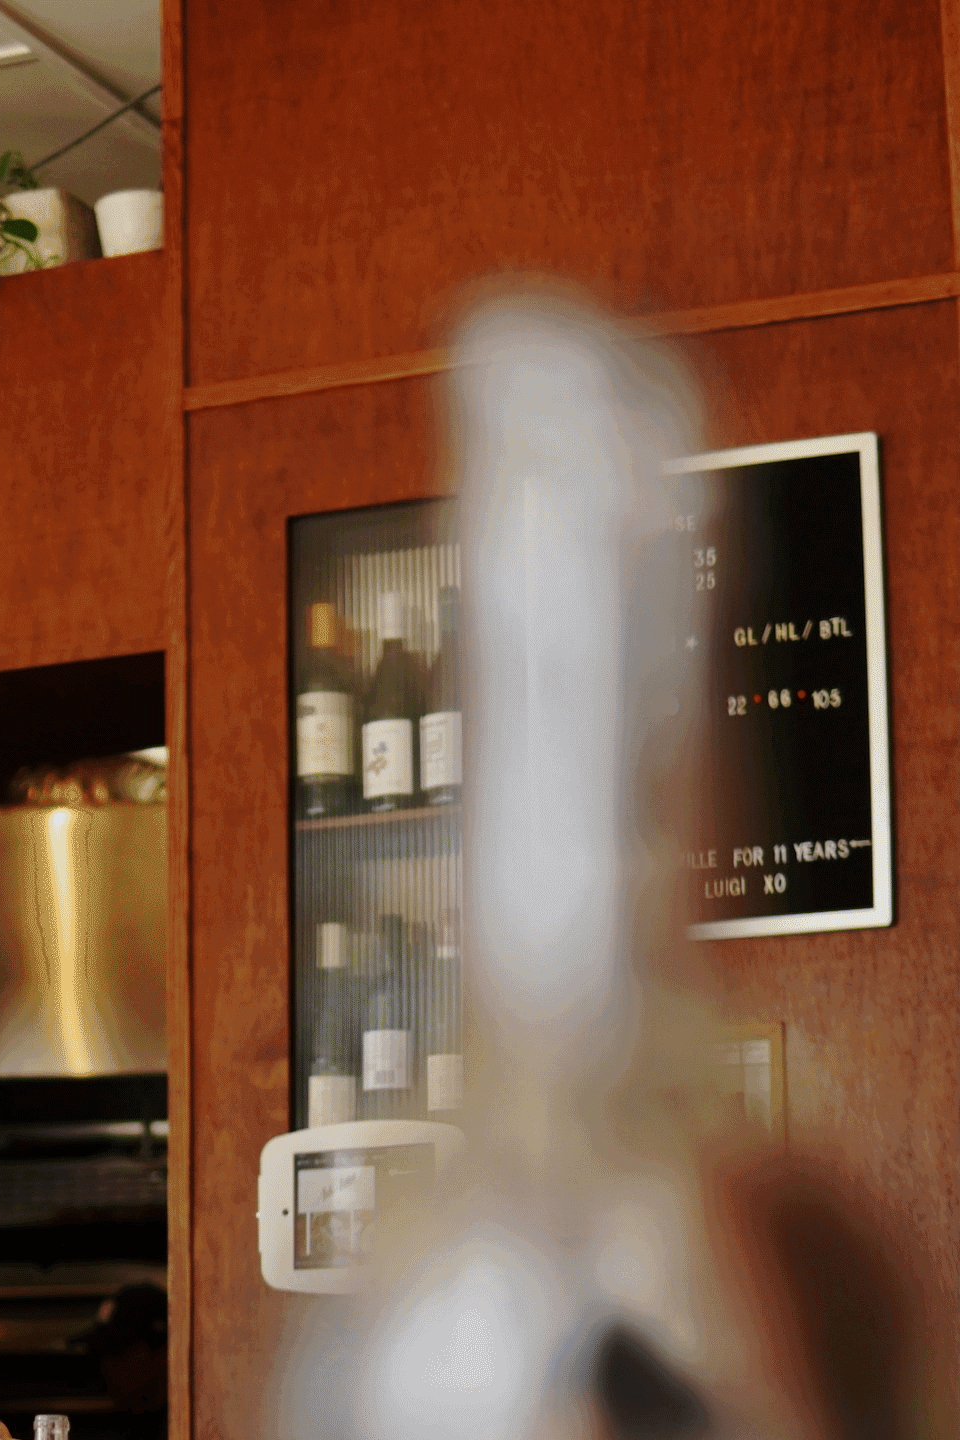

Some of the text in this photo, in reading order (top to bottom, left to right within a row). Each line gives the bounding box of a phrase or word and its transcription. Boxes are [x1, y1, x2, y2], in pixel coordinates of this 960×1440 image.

[811, 687, 842, 711] 105
[732, 845, 765, 869] FOR
[793, 838, 851, 864] YEARS
[704, 875, 746, 900] LUIGI
